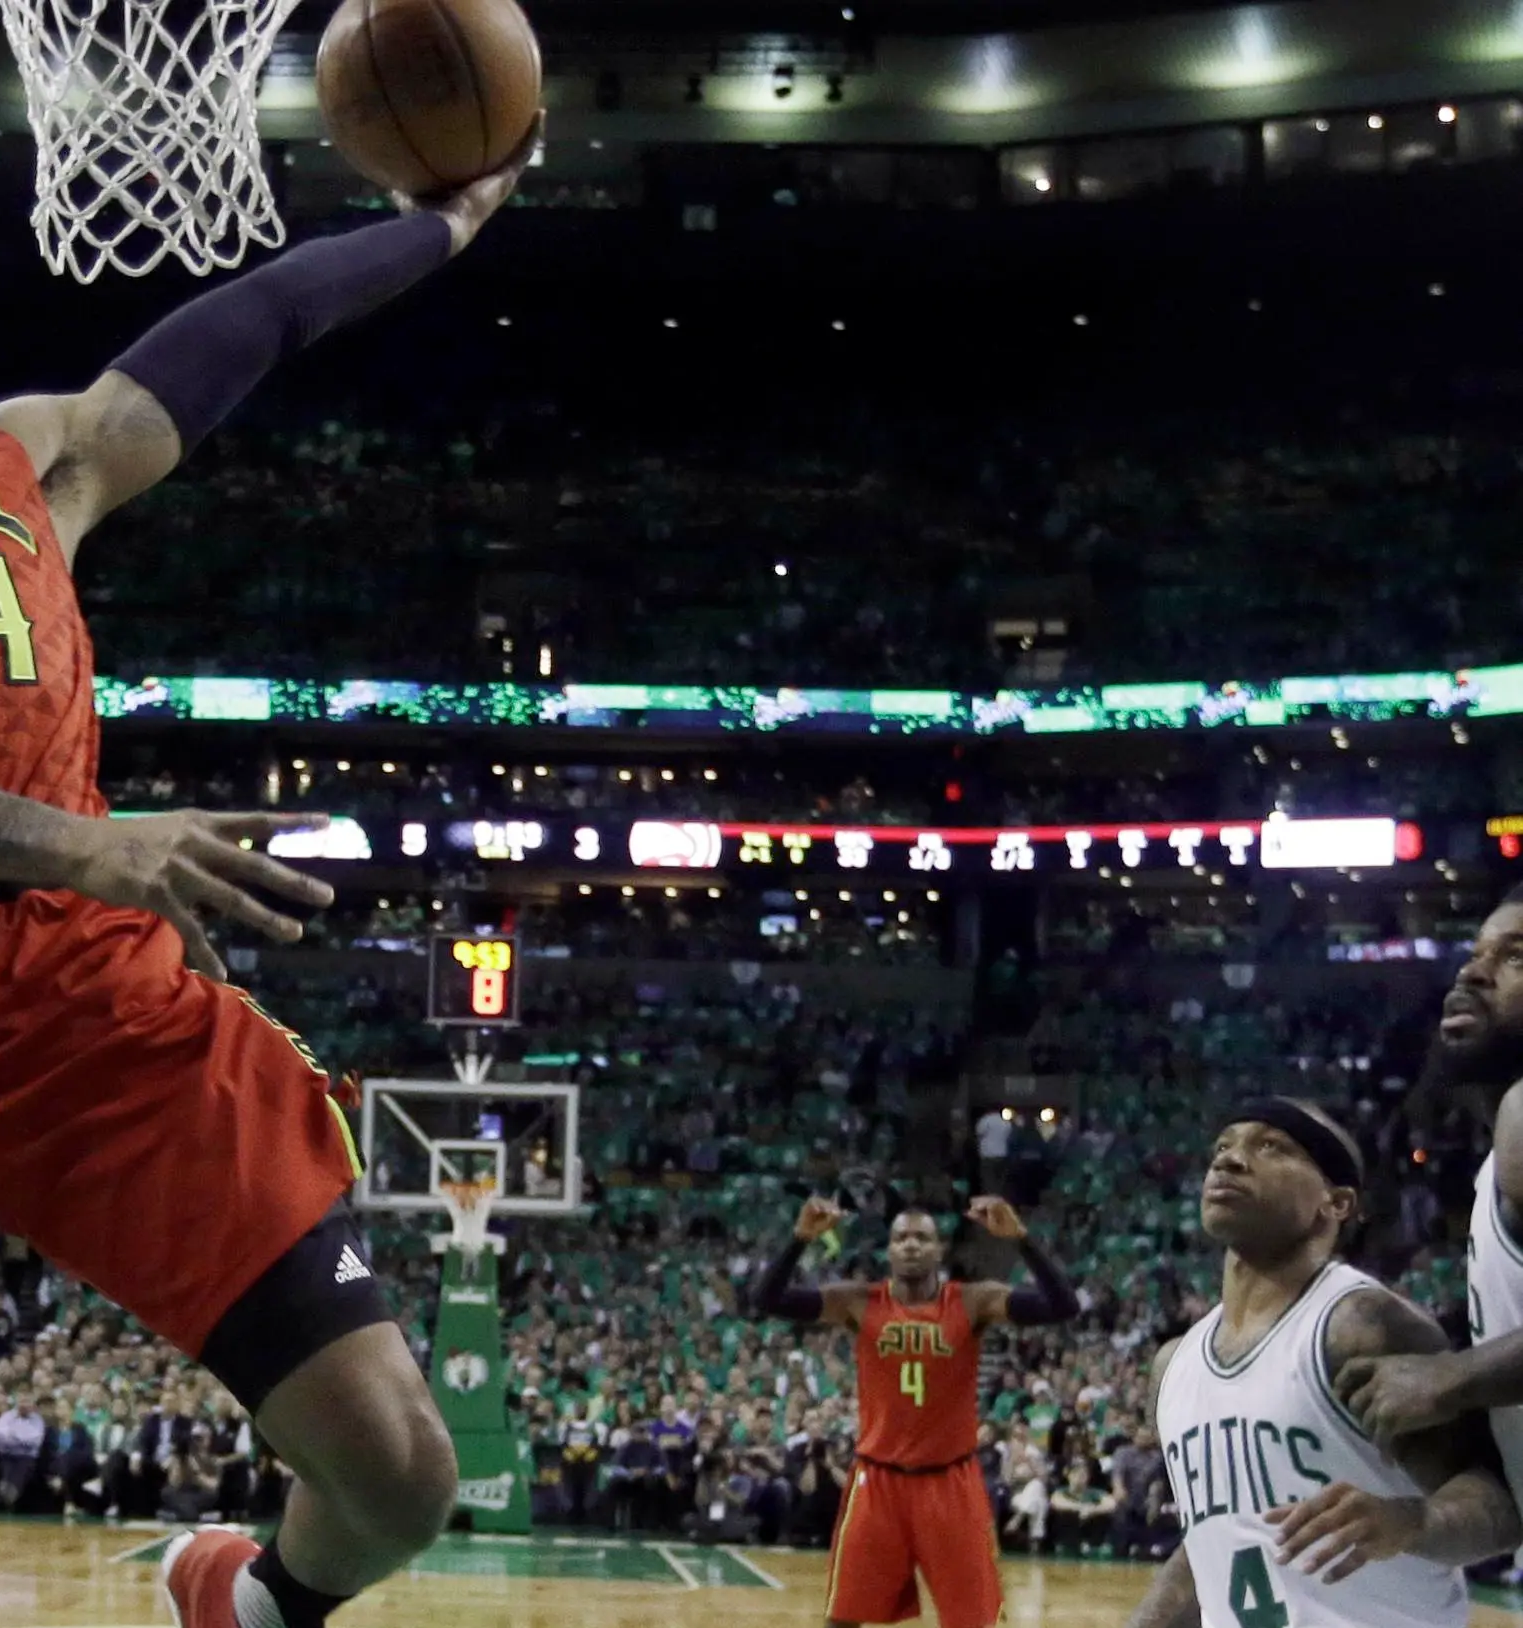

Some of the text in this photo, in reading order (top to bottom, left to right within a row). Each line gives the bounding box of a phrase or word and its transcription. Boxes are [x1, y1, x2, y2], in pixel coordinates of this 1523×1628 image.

[471, 968, 504, 1015] 8
[876, 1320, 953, 1358] ATL
[900, 1361, 926, 1407] 4
[1166, 1416, 1332, 1541] CELTICS
[1228, 1544, 1290, 1628] 4
